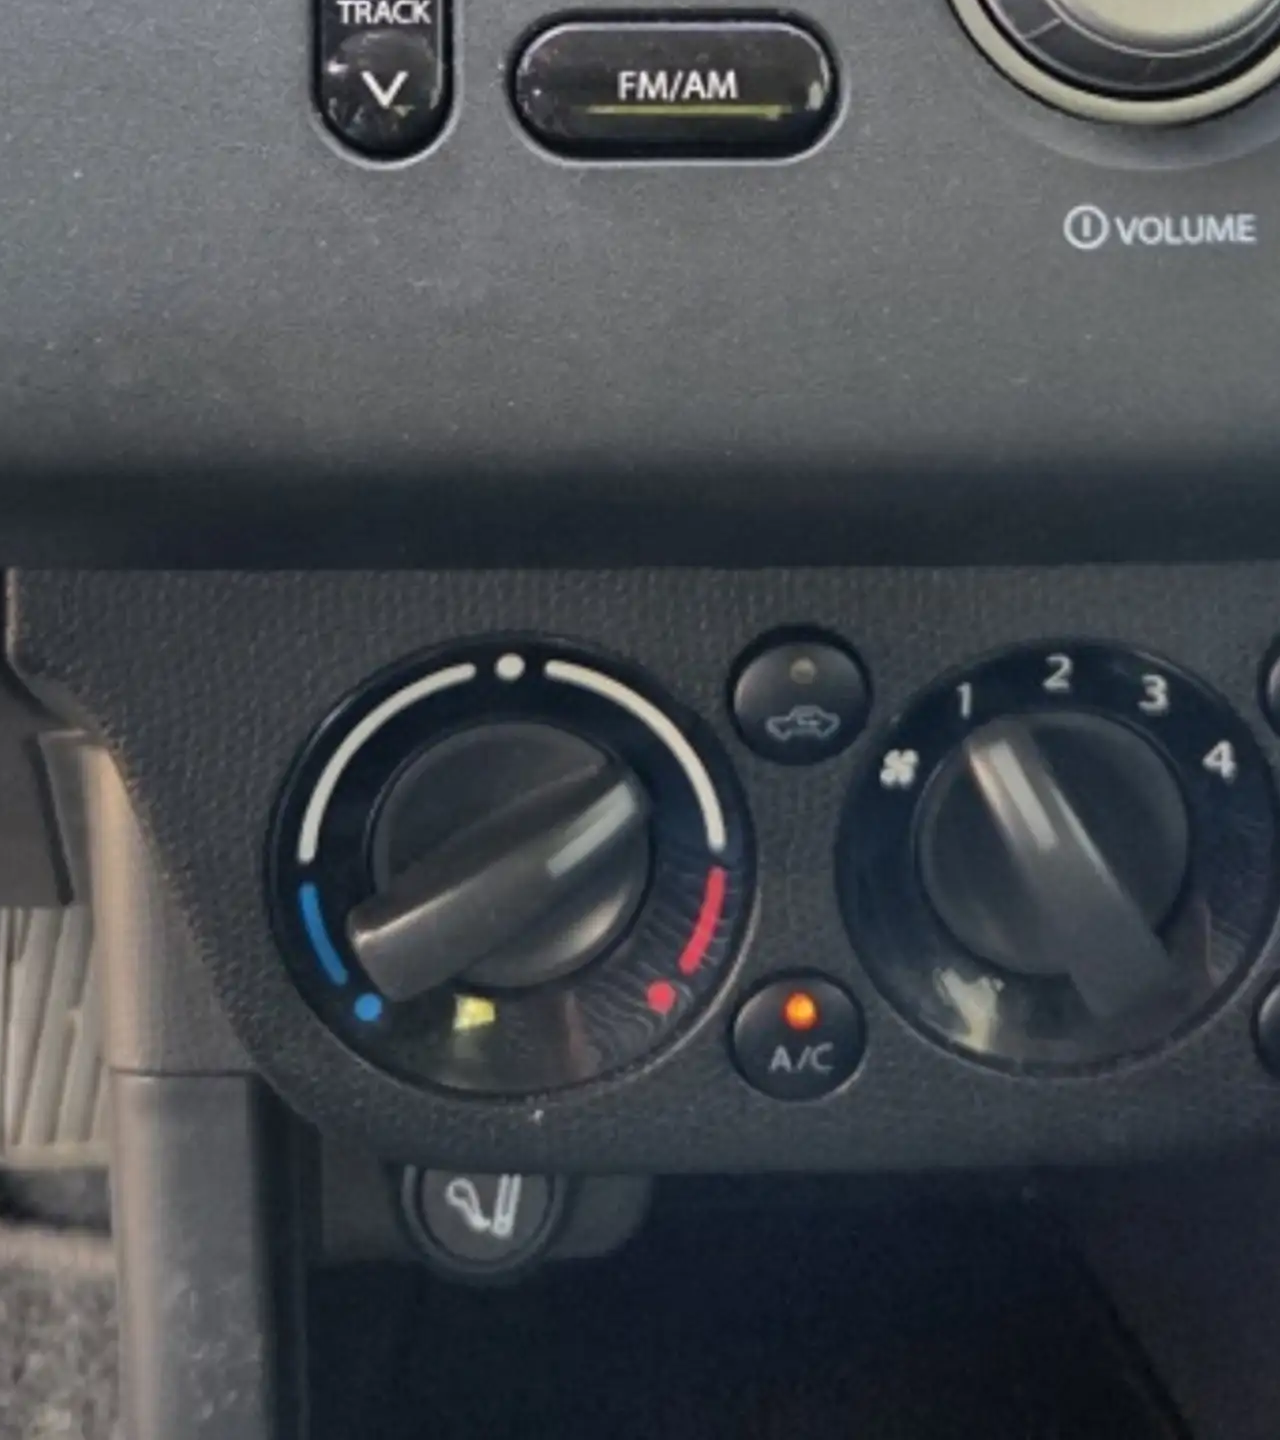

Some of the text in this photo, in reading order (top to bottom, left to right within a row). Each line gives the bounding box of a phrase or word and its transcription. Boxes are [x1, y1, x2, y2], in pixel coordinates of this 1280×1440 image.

[335, 0, 433, 25] TRACK
[616, 69, 740, 102] FM/AM
[1114, 212, 1258, 246] VOLUME
[955, 651, 1238, 785] 1 2 3 4
[768, 1041, 836, 1075] A/C
